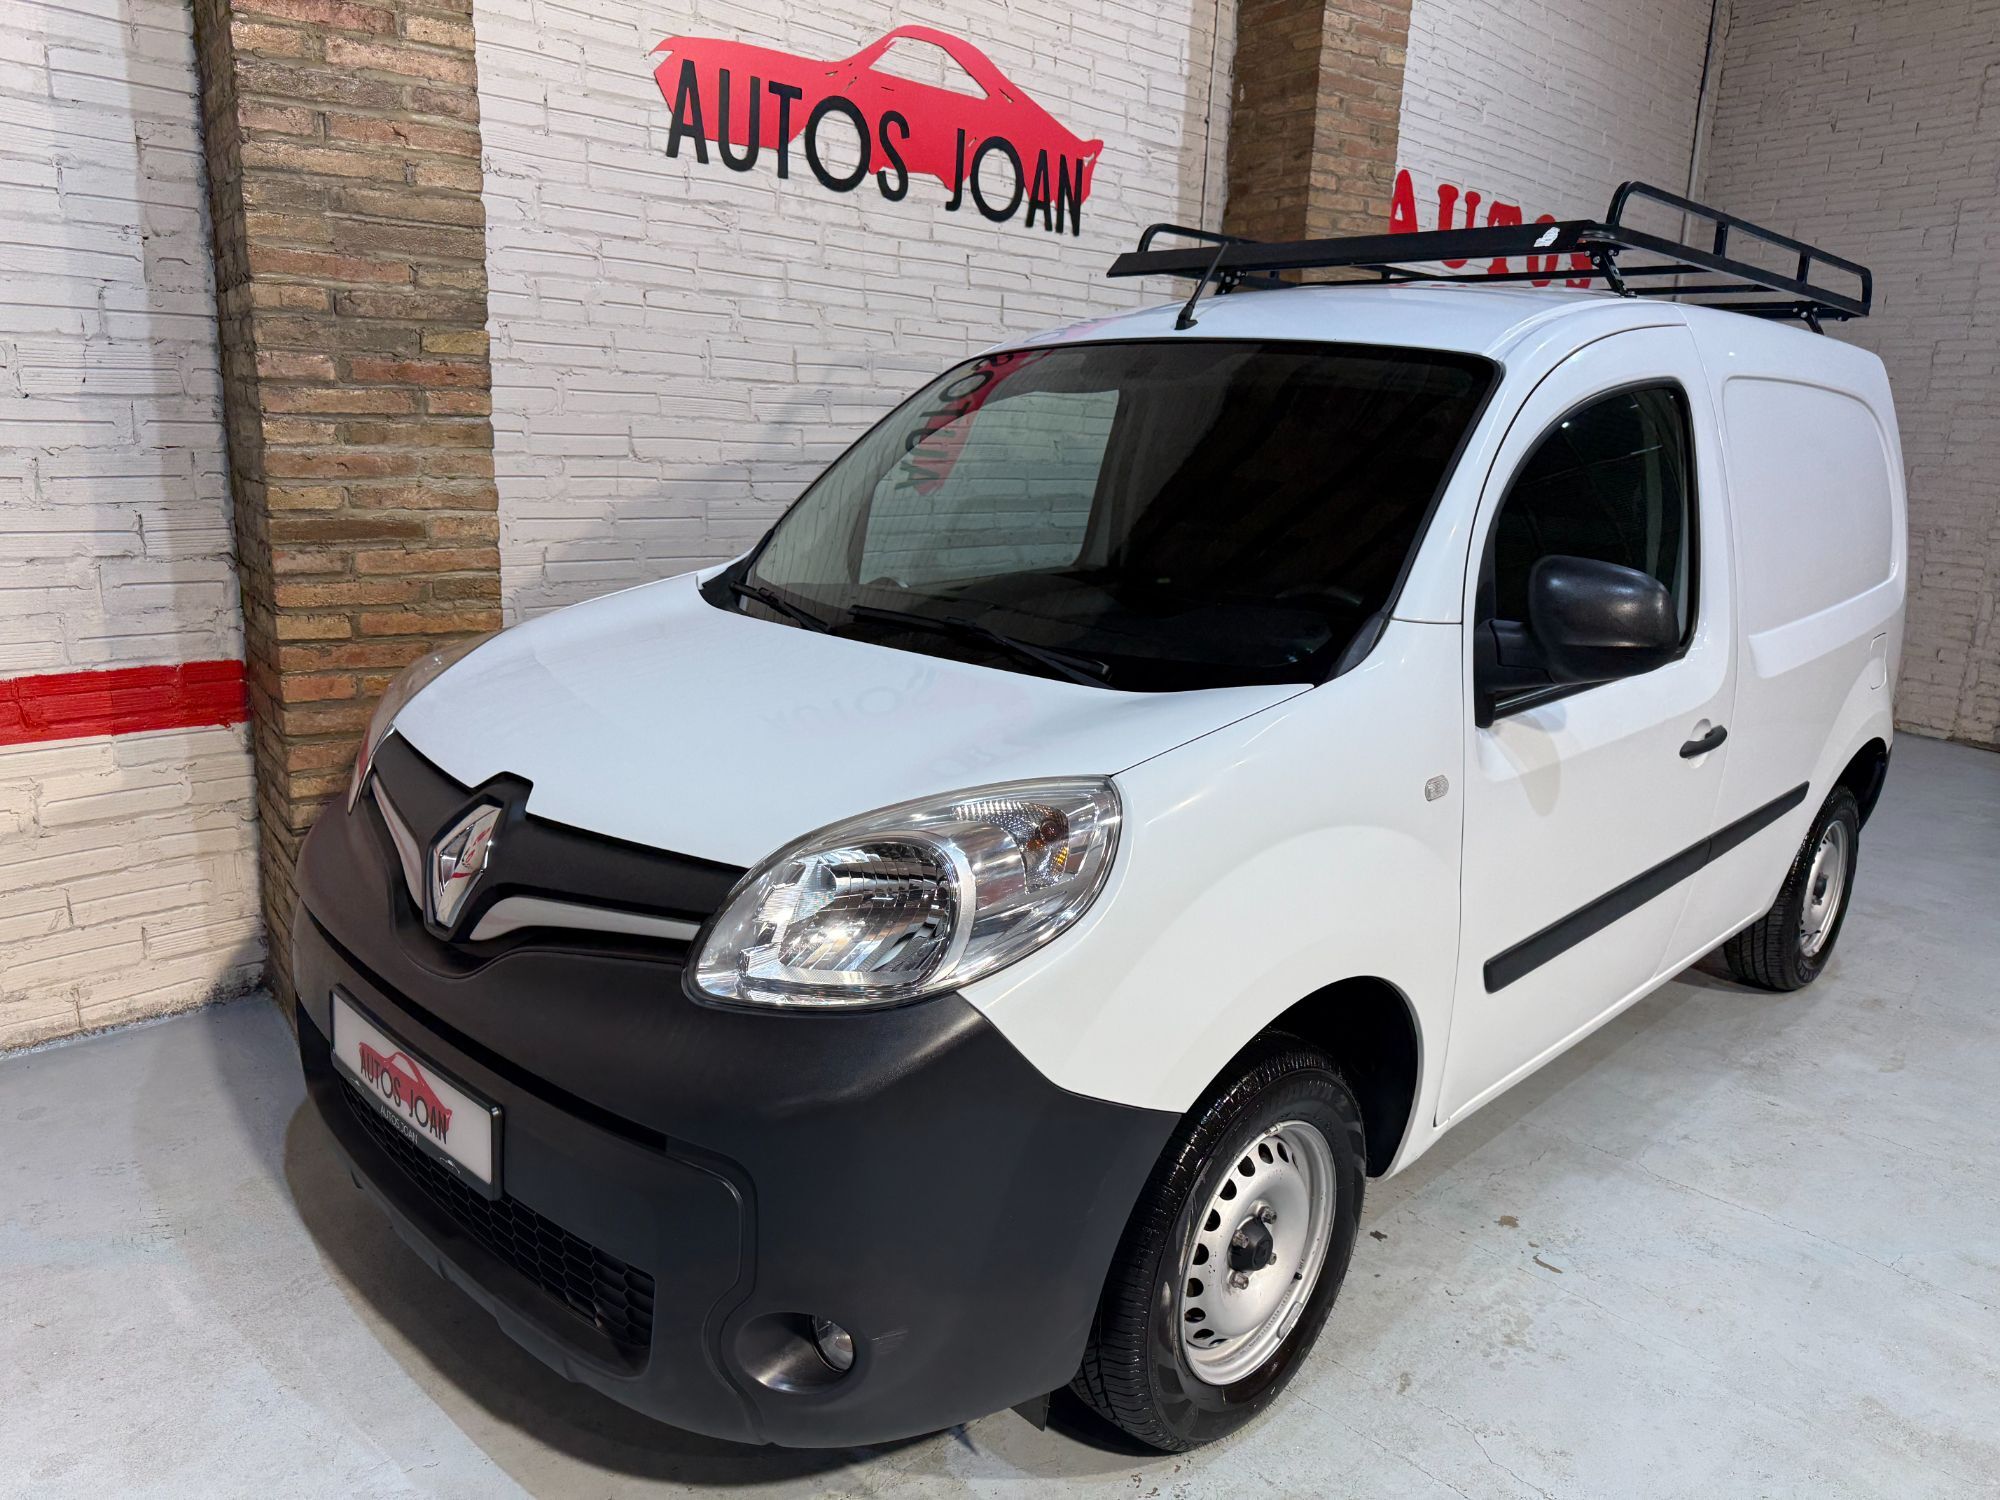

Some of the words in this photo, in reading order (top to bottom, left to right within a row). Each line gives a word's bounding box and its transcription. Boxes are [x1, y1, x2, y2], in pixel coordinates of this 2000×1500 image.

[666, 59, 910, 202] AUTOS
[945, 127, 1084, 236] JOAN
[361, 1048, 401, 1107] AUTOS
[409, 1088, 447, 1145] JOAN
